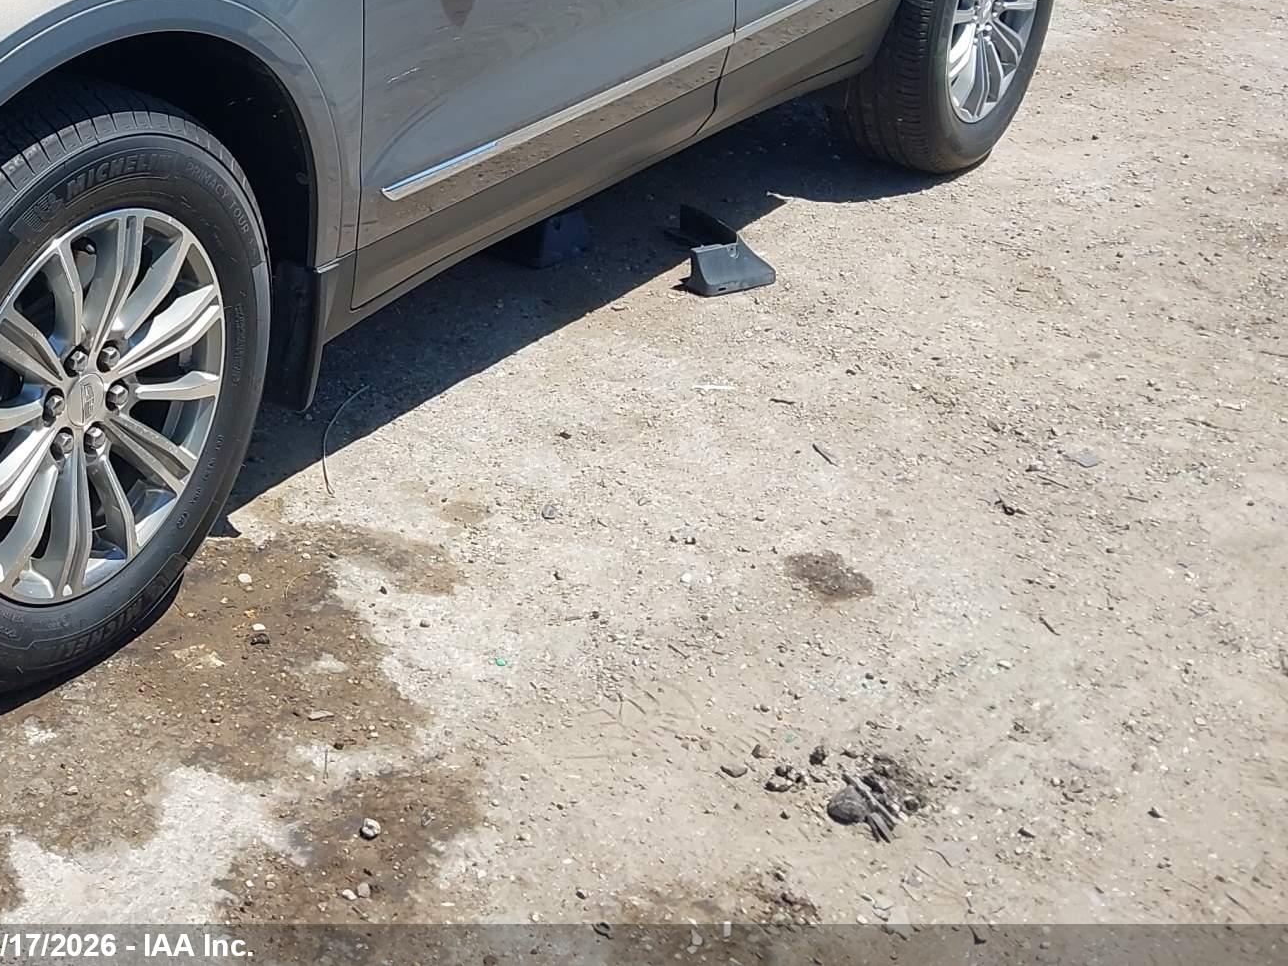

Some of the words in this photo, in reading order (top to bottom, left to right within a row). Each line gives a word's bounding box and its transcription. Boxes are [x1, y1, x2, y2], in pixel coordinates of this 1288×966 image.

[66, 152, 176, 200] MICHELIN
[185, 160, 231, 199] PRIMACY
[229, 199, 251, 233] TOUR
